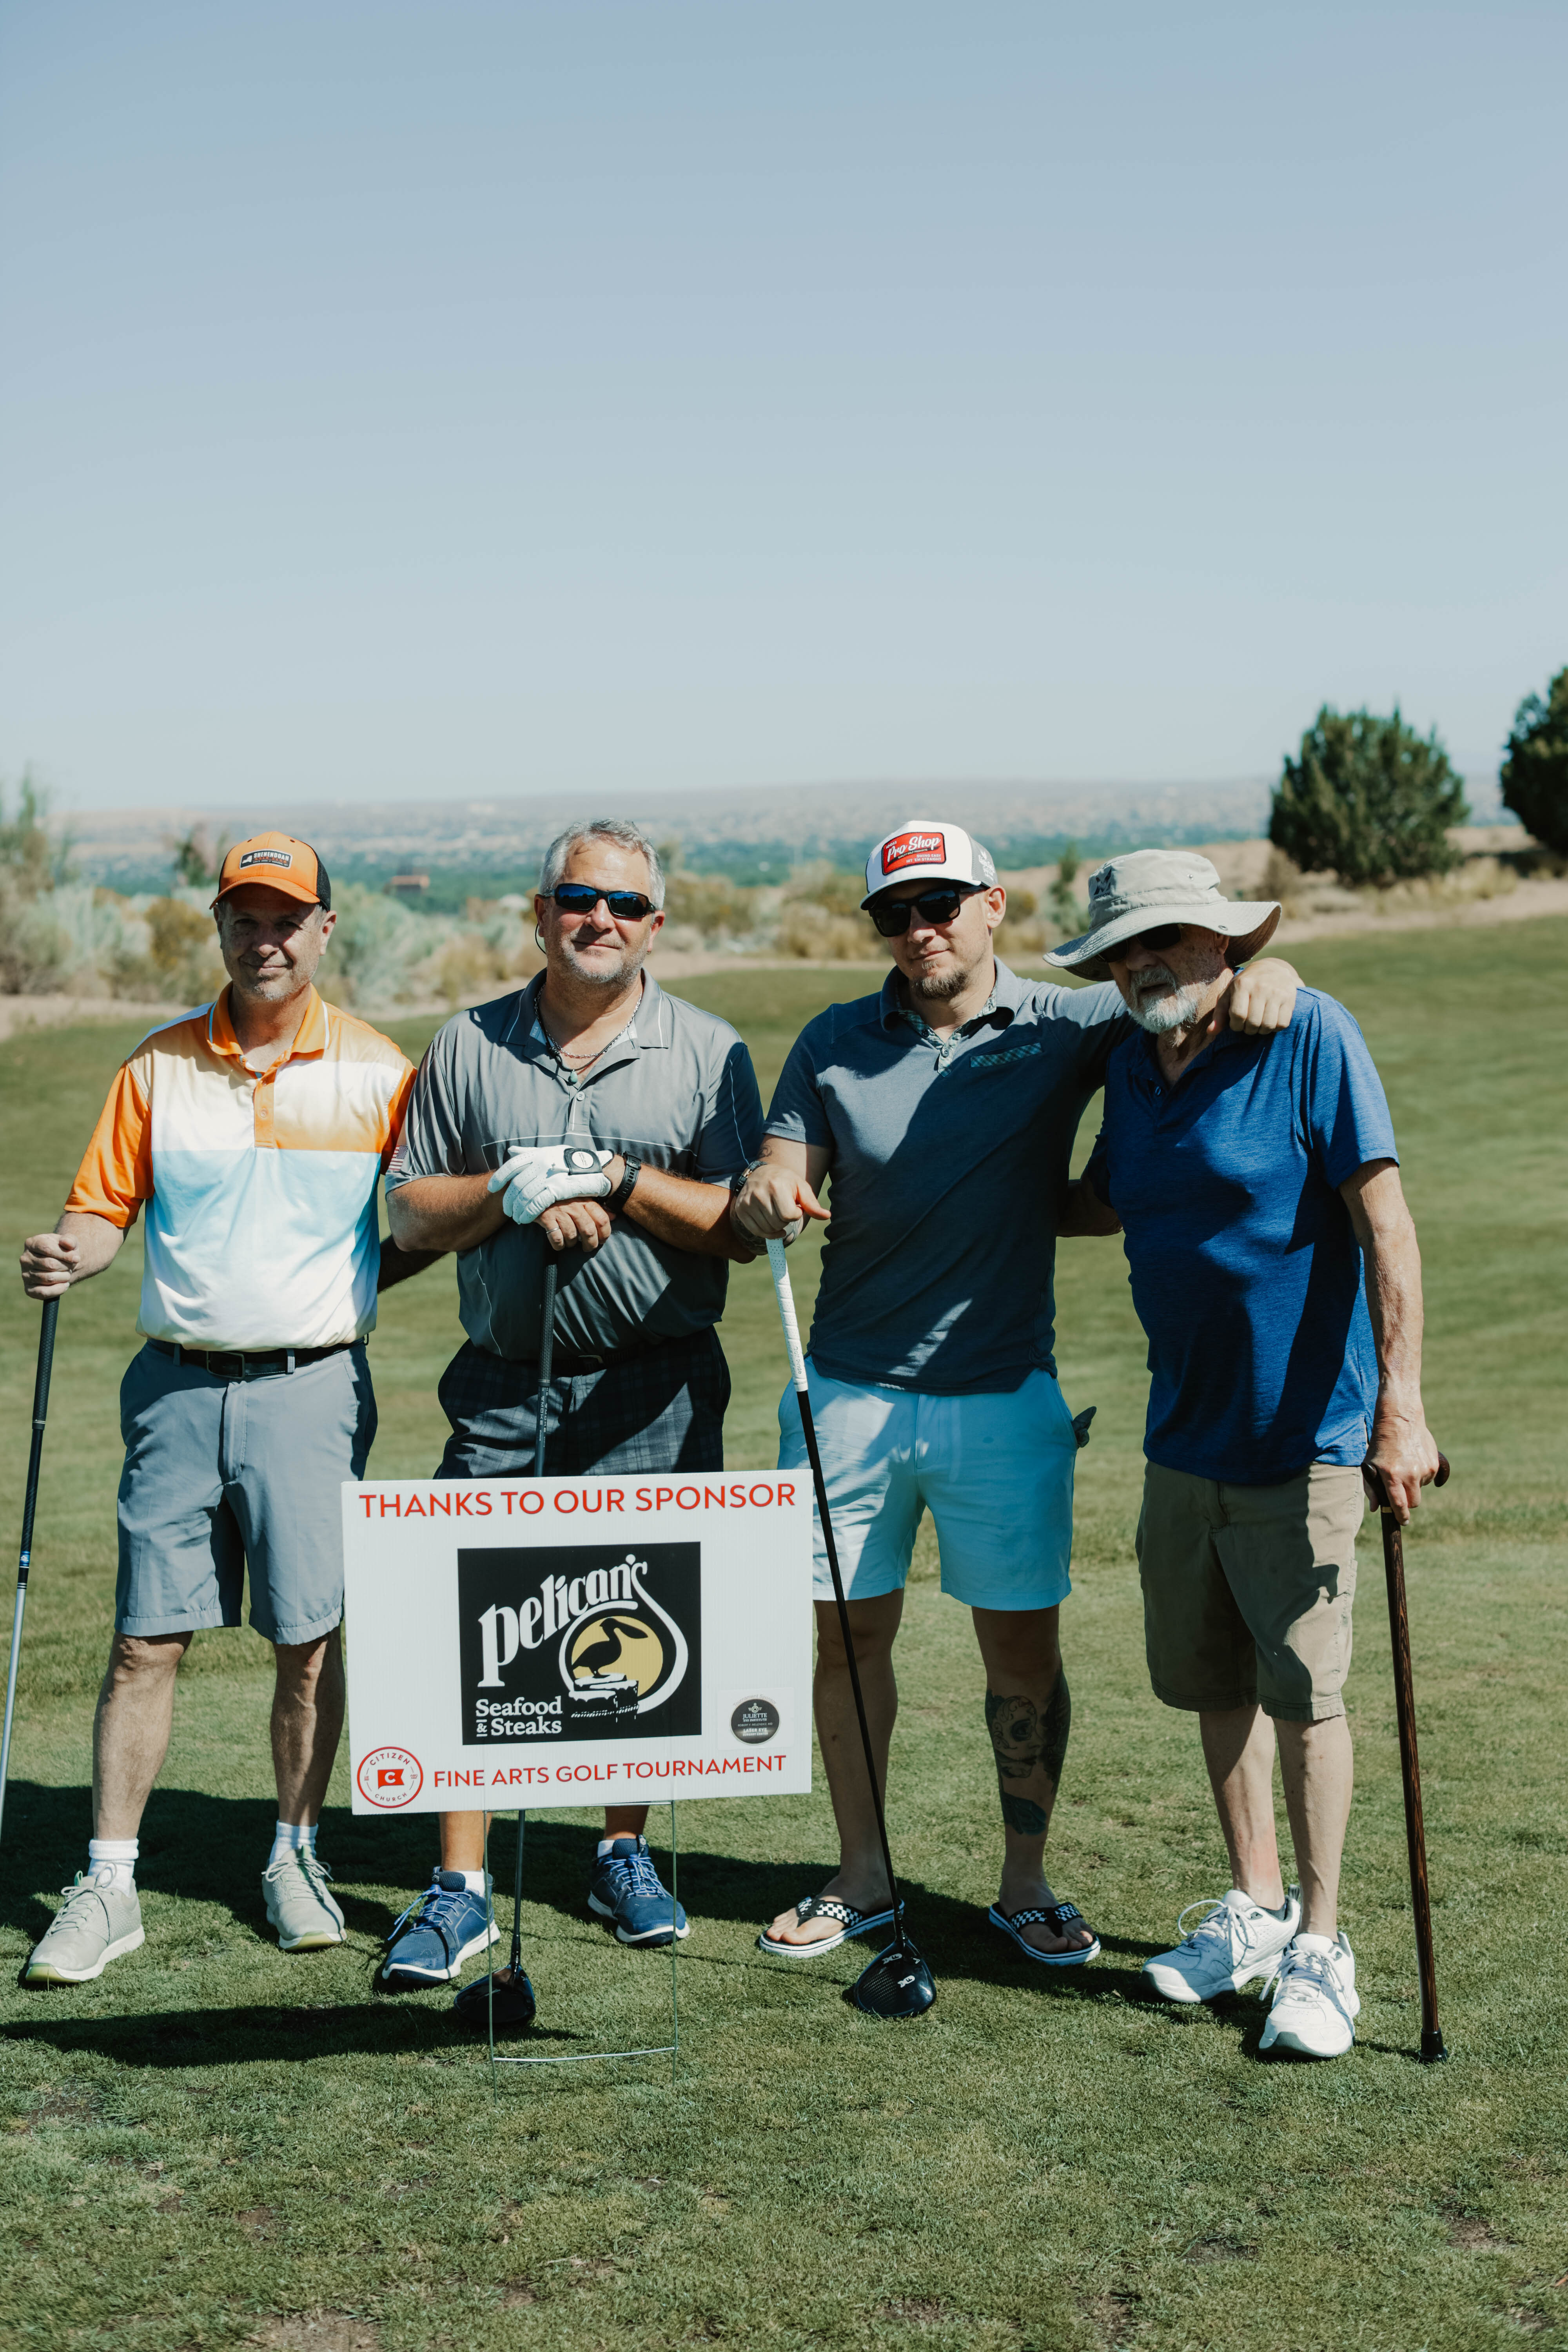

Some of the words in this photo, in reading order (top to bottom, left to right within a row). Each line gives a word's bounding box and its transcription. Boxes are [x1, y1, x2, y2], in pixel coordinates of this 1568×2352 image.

[886, 840, 897, 849] ADIDAS
[887, 844, 907, 862] Pro
[908, 835, 941, 851] Shop
[254, 851, 289, 861] SHENENDOAH
[359, 1492, 492, 1517] THANKS
[501, 1491, 544, 1514] TO
[554, 1489, 624, 1513] OUR
[636, 1484, 795, 1511] SPONSOR
[475, 1695, 563, 1717] Seafood
[476, 1722, 488, 1734] &
[491, 1715, 562, 1736] Steaks
[370, 1753, 410, 1766] CITIZEN
[385, 1771, 396, 1784] C
[435, 1770, 485, 1788] FINE
[492, 1767, 549, 1785] ARTS
[556, 1764, 617, 1782] GOLF
[623, 1755, 786, 1779] TOURNAMENT
[375, 1792, 407, 1802] CHURCH
